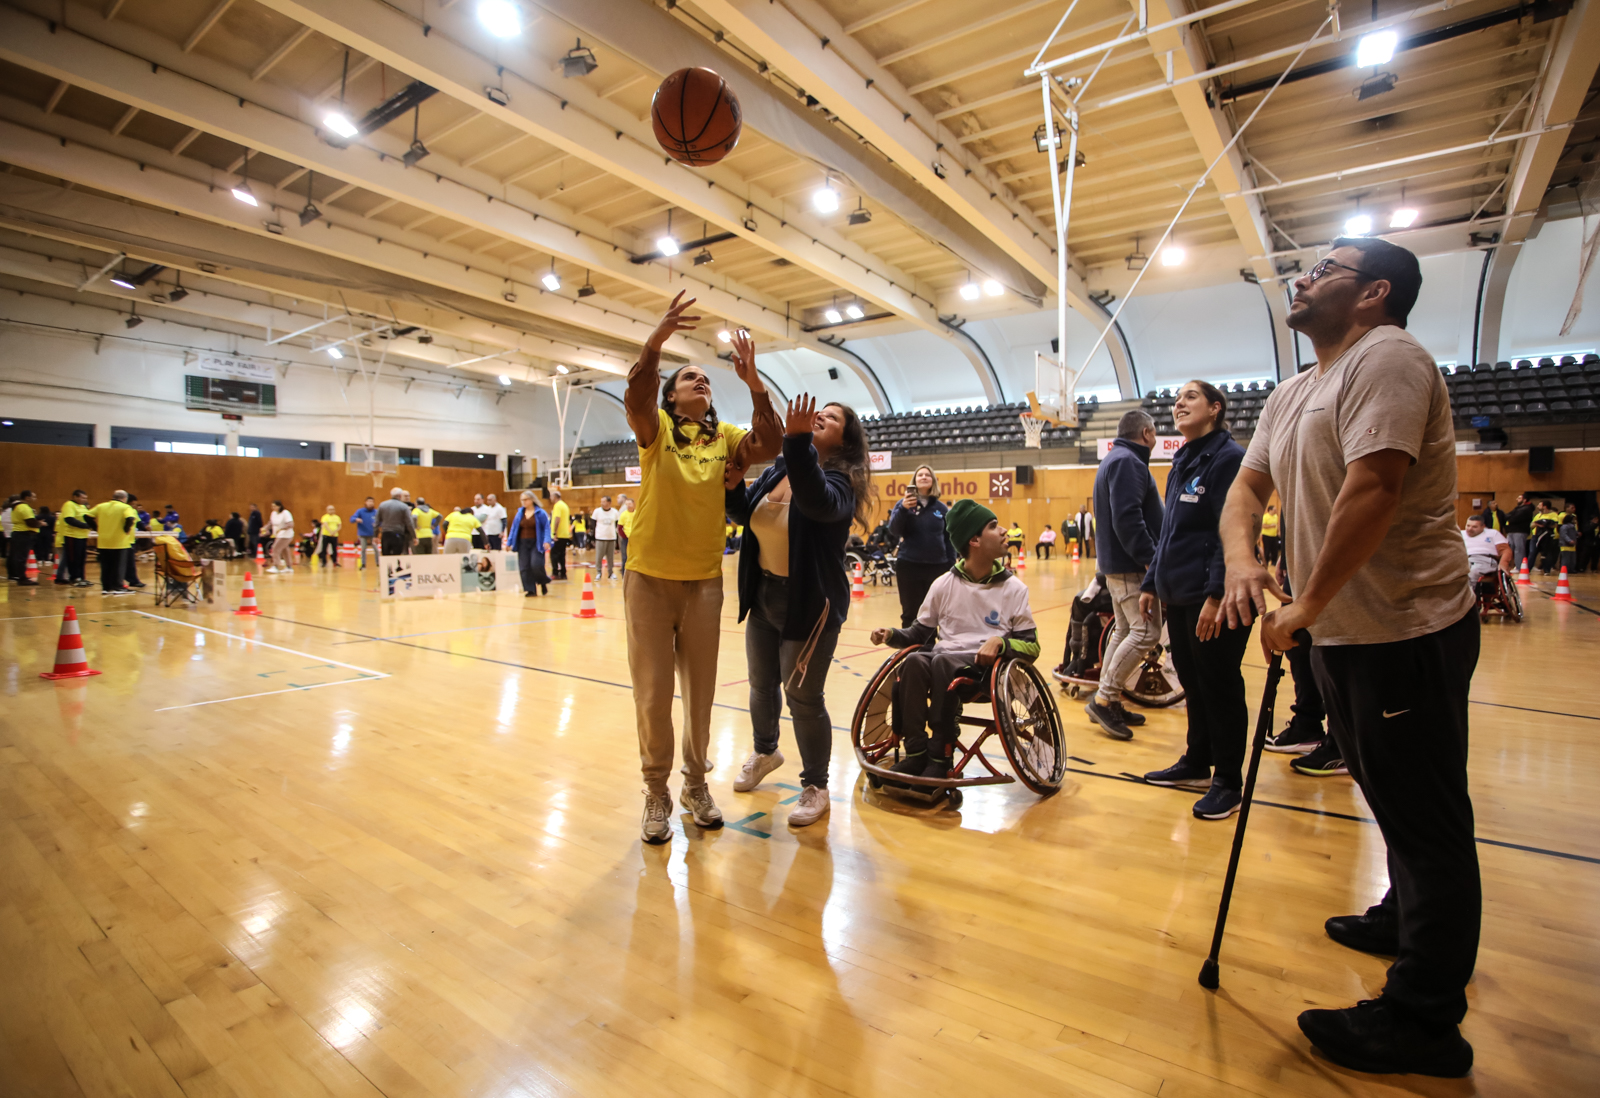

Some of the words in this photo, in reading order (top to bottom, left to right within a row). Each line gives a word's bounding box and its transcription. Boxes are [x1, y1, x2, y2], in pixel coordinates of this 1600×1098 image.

[213, 358, 234, 367] PLAY
[886, 479, 907, 497] do
[937, 477, 978, 495] nho
[417, 573, 455, 585] BRAGA
